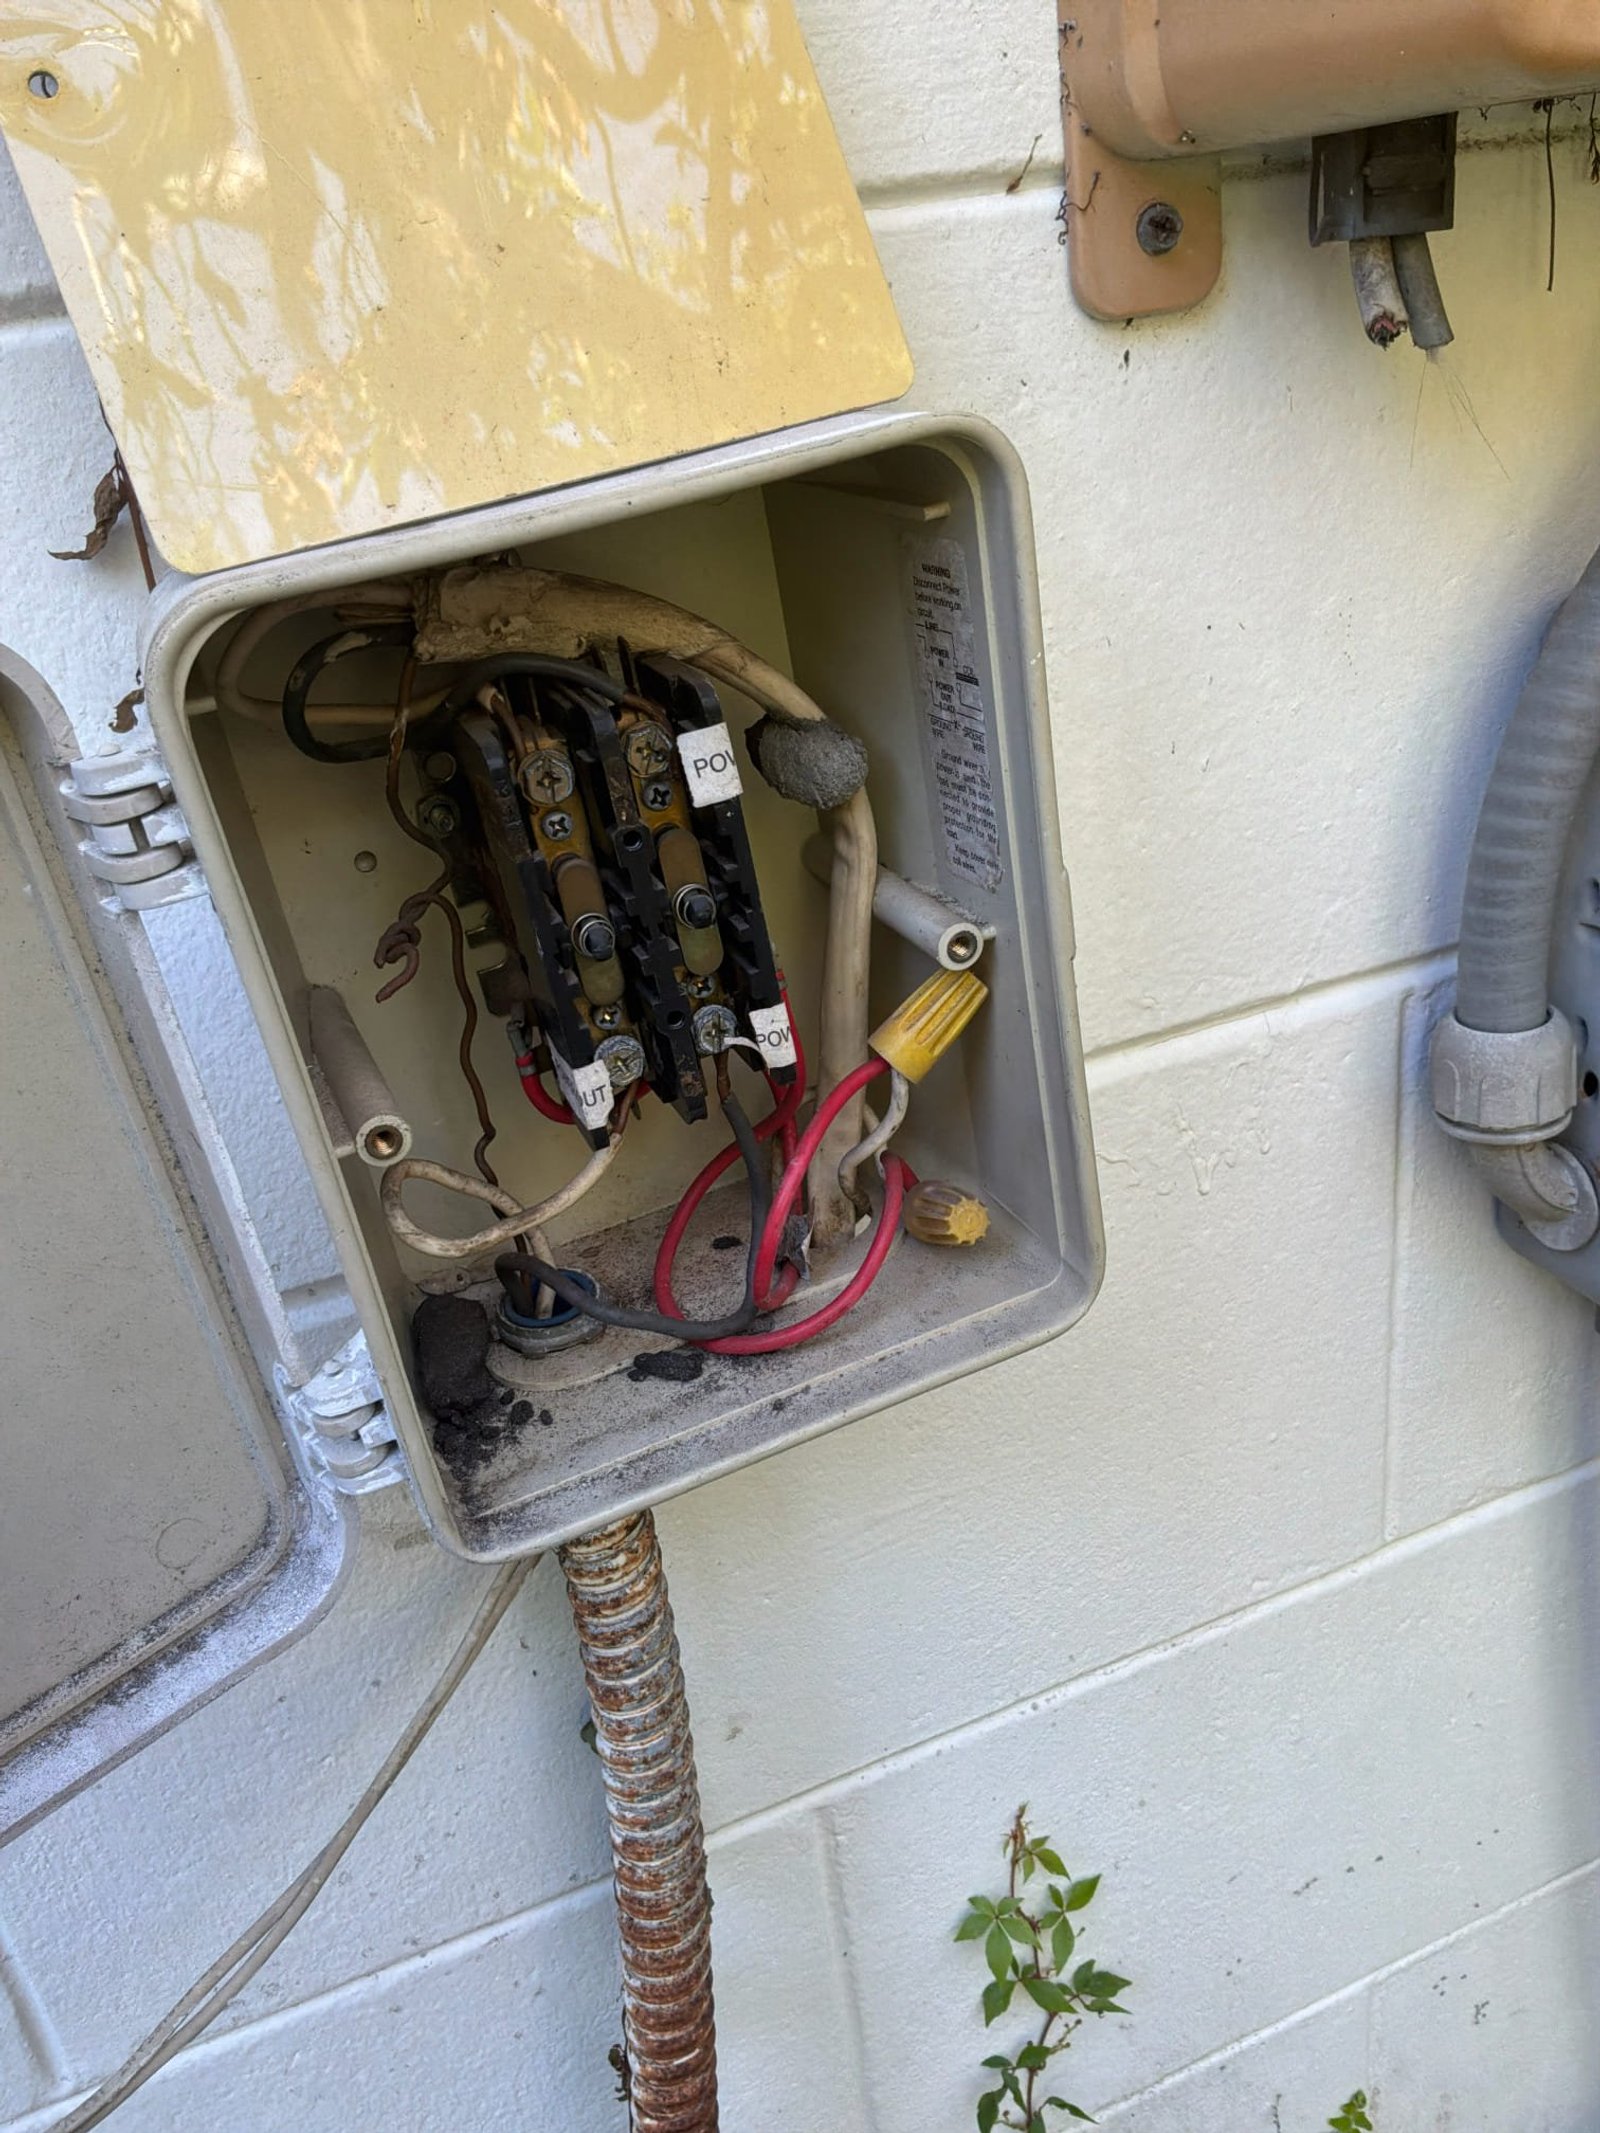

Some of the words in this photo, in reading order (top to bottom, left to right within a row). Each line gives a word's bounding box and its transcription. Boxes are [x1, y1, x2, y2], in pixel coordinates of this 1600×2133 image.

[912, 576, 942, 591] Disconnect
[942, 583, 960, 596] Power
[914, 592, 932, 603] before
[933, 597, 954, 612] working
[930, 646, 950, 659] POWER
[935, 680, 955, 695] POWER
[971, 801, 995, 817] provide
